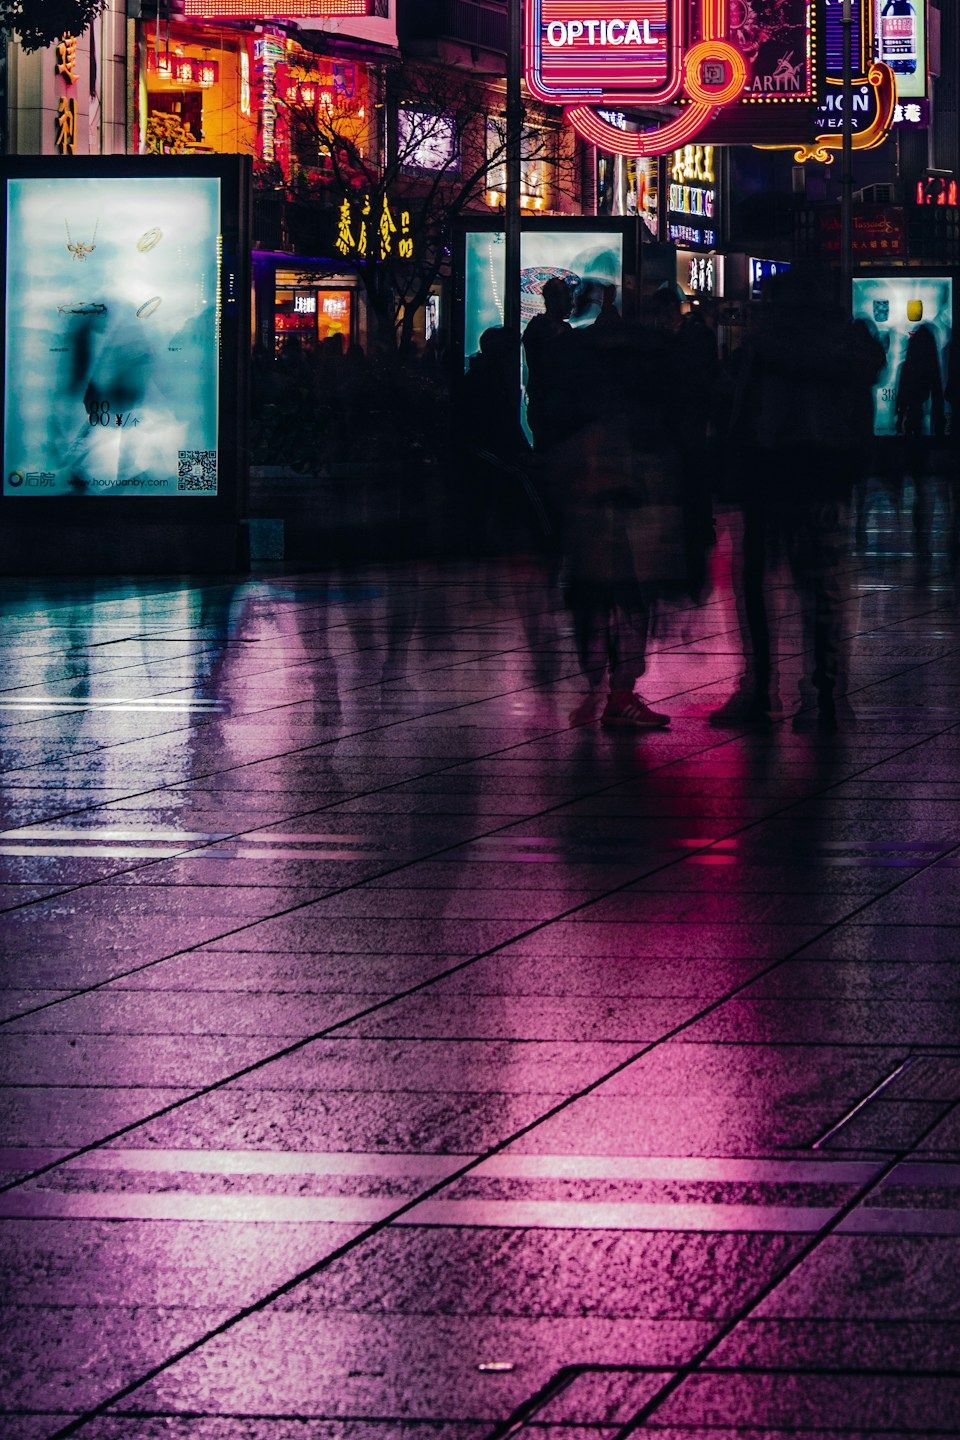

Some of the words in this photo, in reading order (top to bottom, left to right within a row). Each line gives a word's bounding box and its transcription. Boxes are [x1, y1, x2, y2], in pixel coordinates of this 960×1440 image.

[546, 18, 658, 47] OPTICAL
[744, 75, 800, 92] ARTIN
[25, 471, 56, 488] 后院
[67, 477, 169, 489] www.houyuanby.com
